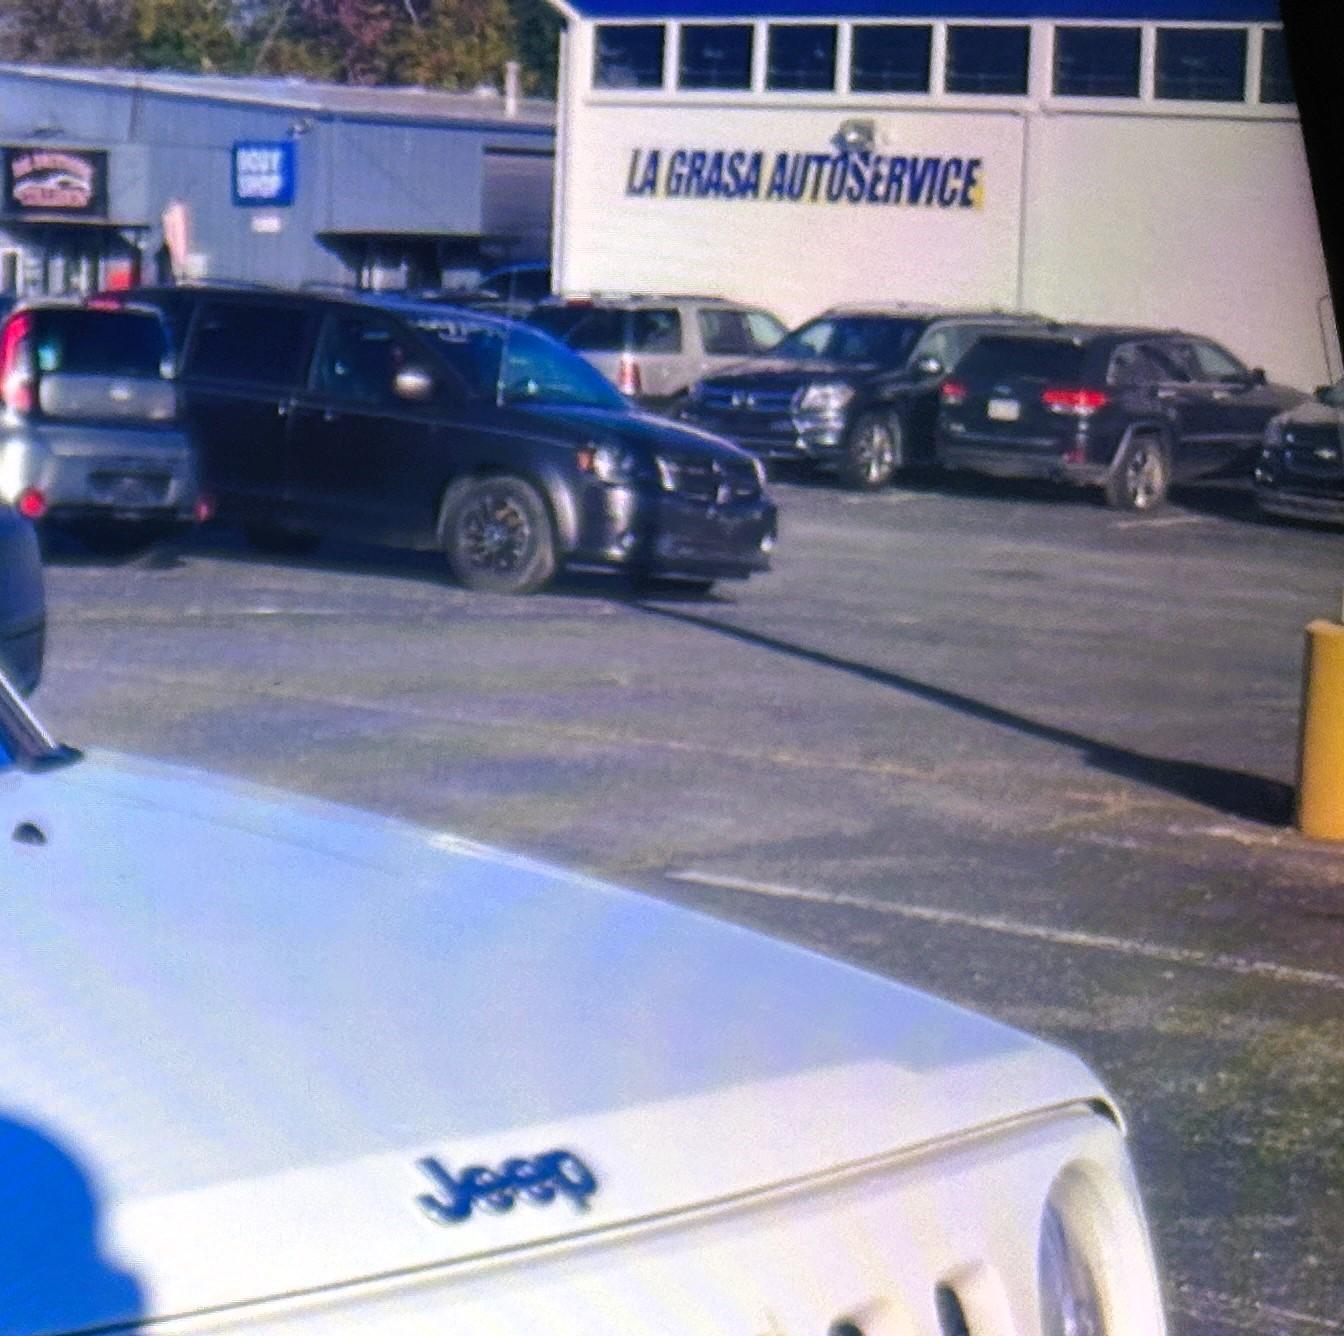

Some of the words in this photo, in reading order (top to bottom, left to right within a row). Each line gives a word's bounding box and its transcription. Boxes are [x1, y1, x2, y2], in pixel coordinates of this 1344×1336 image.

[626, 149, 661, 196] LA
[666, 150, 764, 199] GRASA
[766, 152, 983, 208] AUTOSERVICE
[415, 1148, 598, 1226] Jeep
